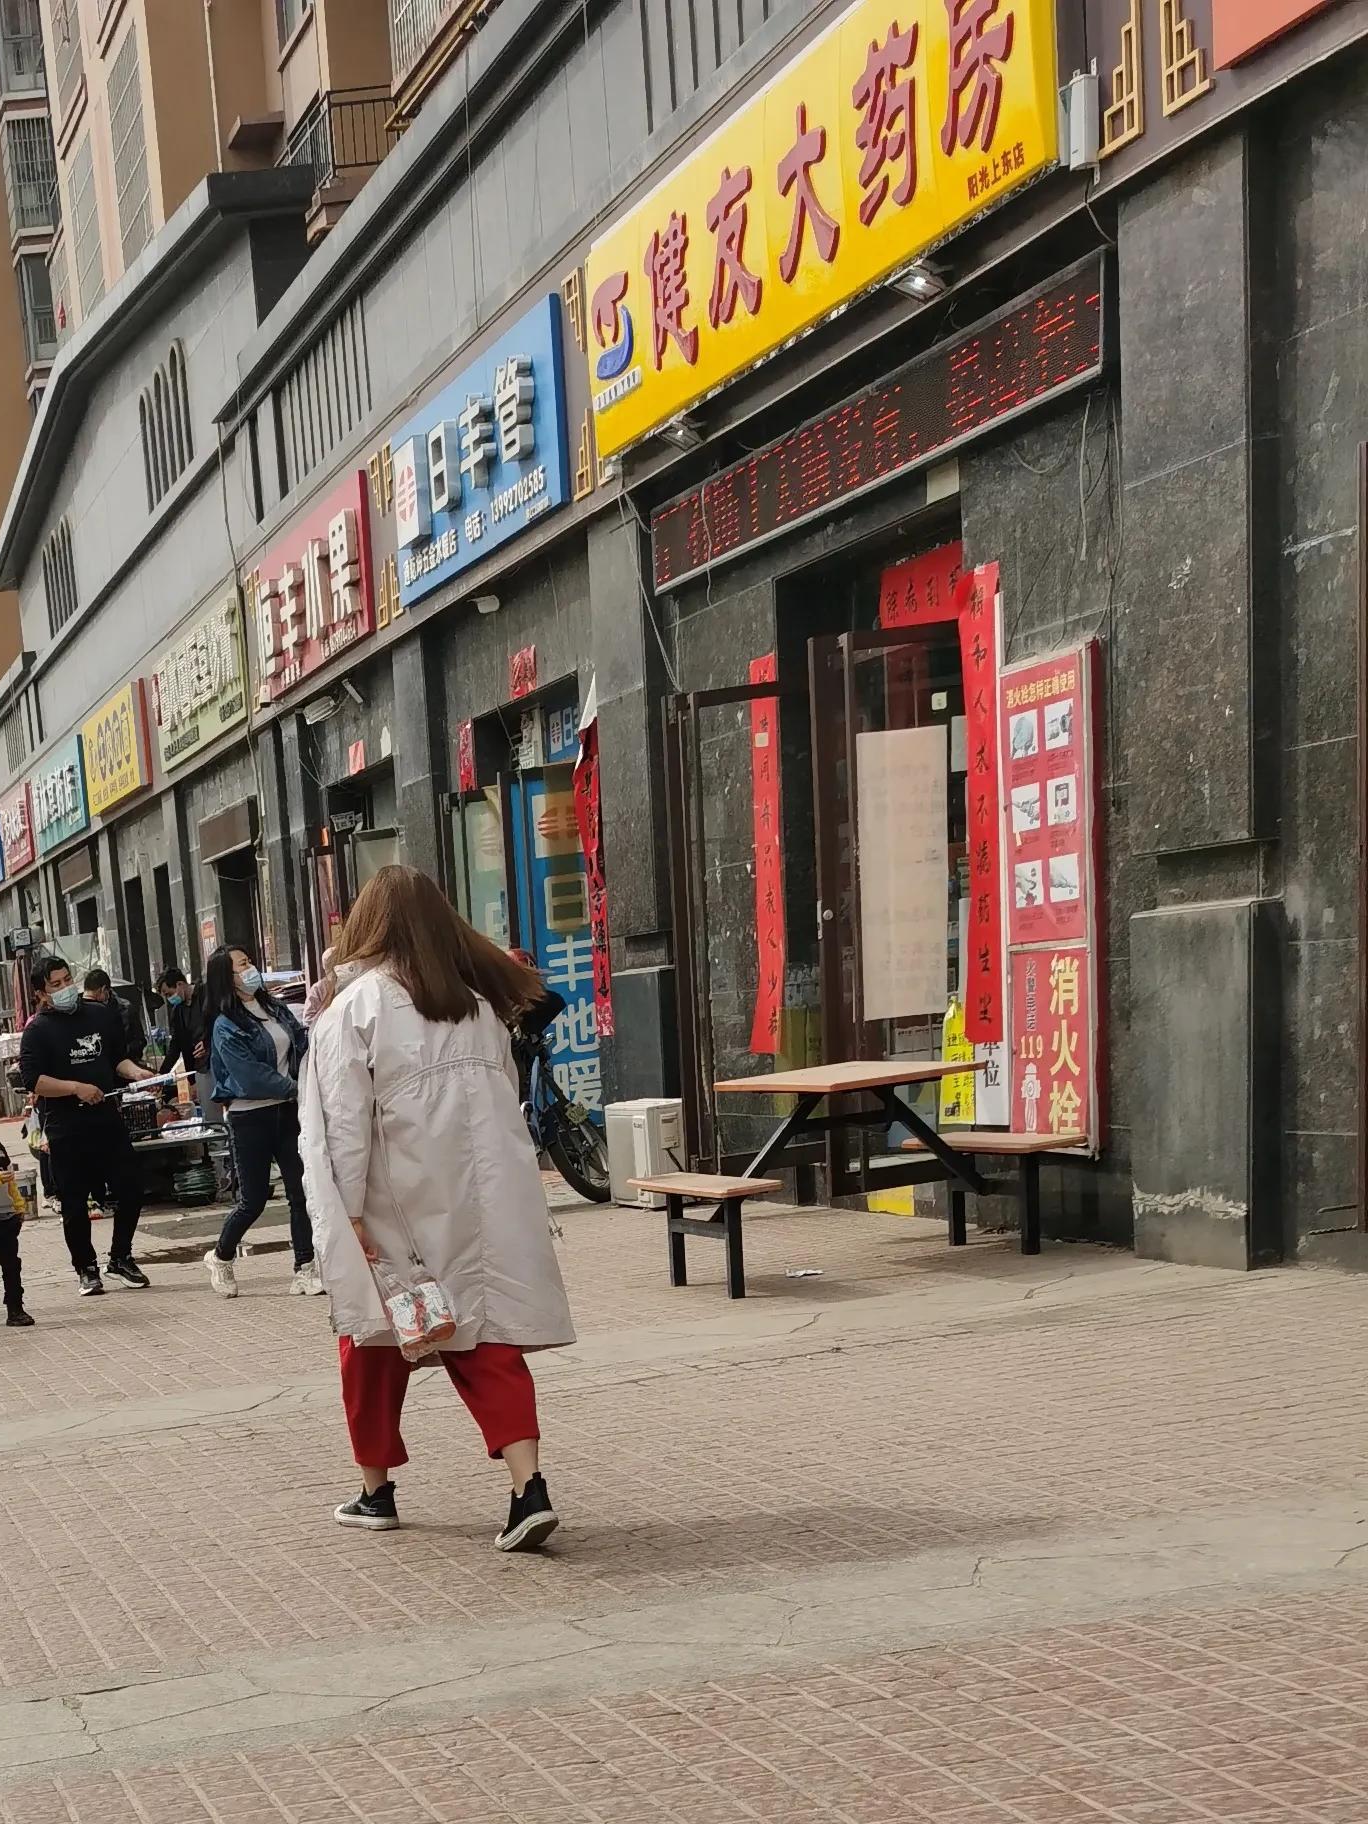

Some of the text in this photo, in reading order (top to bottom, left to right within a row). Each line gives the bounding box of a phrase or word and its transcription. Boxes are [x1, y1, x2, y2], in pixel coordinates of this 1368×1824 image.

[644, 0, 1015, 372] 健友大药房
[967, 141, 1025, 202] 阳光上东店
[428, 354, 536, 515] 日丰管
[490, 464, 546, 523] 13992702585
[256, 507, 362, 682] 恒丰水果
[1005, 669, 1076, 709] 消火栓怎样正确使用
[543, 871, 604, 1113] 日丰地暖
[1019, 1033, 1044, 1059] 119
[1048, 953, 1083, 1135] 消火栓
